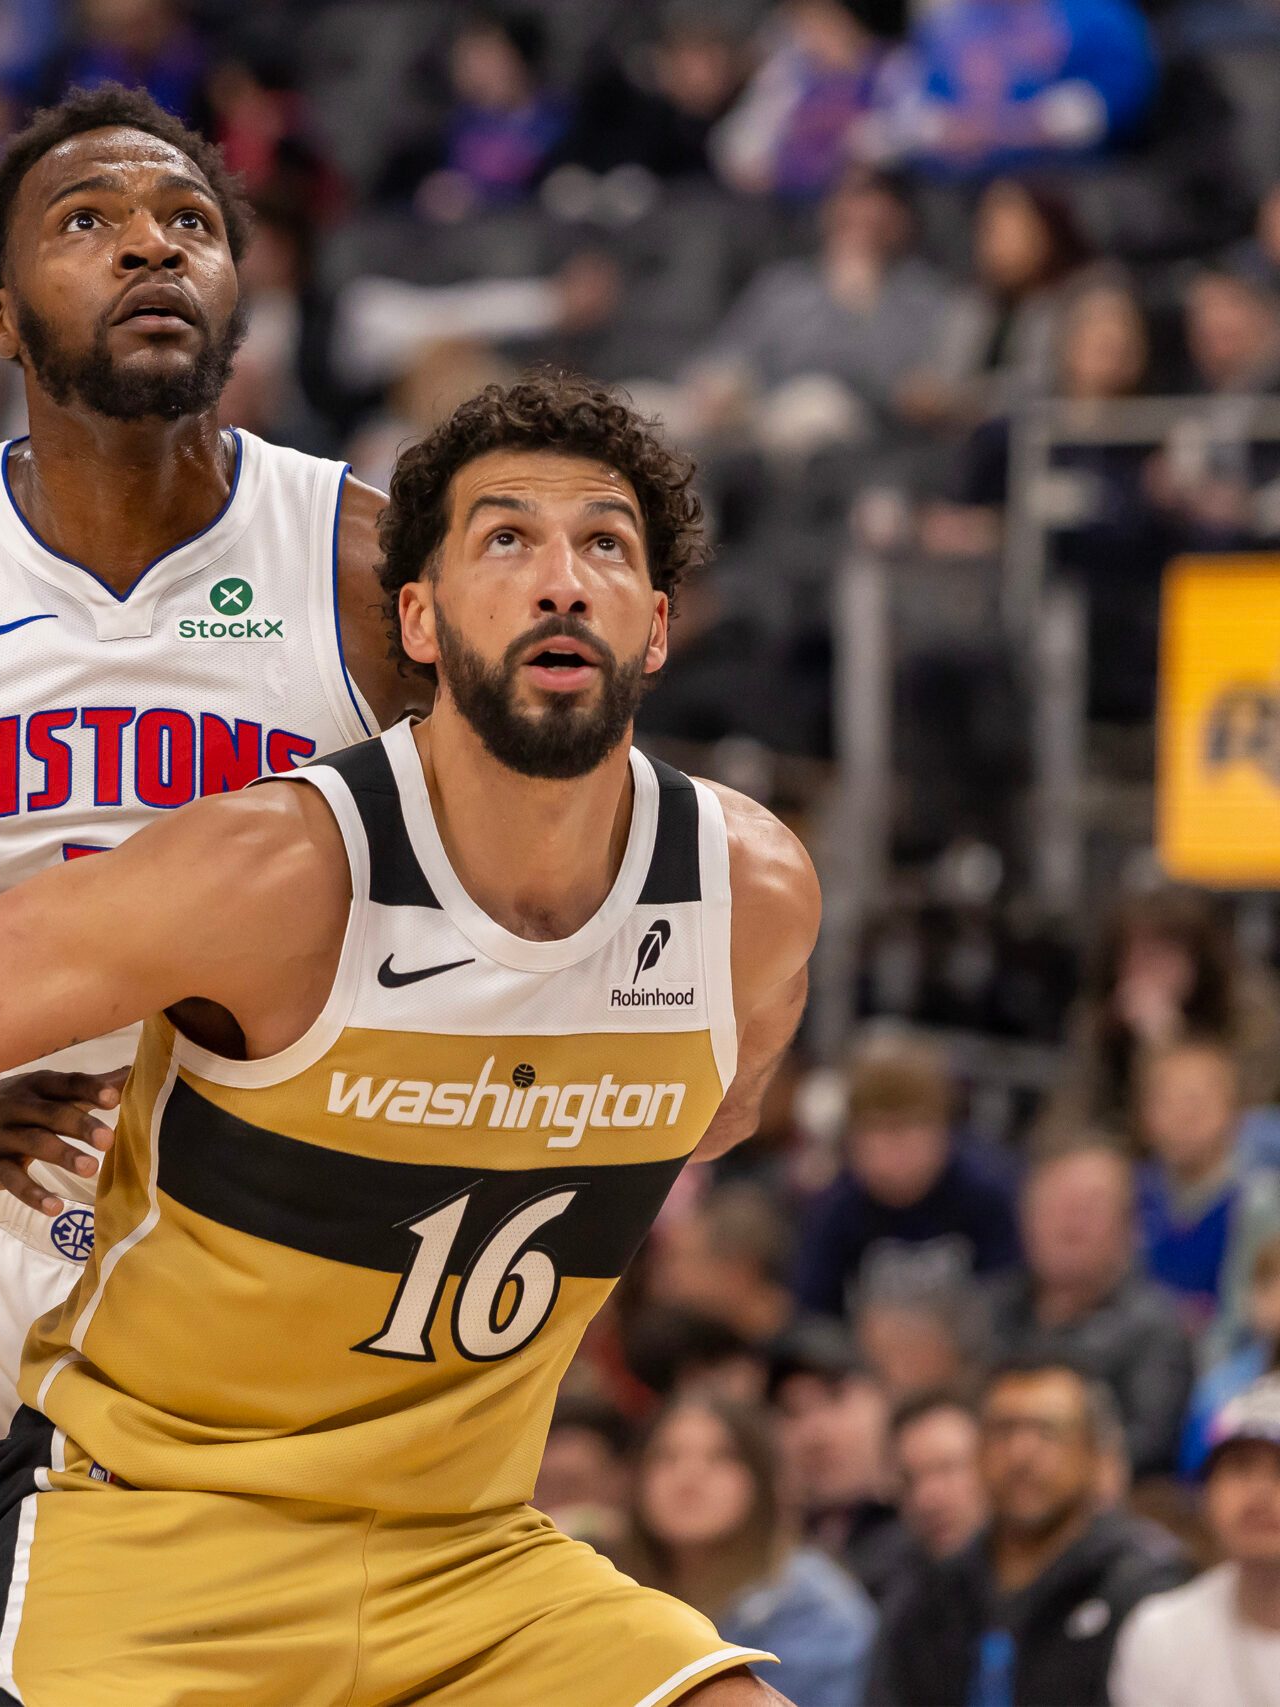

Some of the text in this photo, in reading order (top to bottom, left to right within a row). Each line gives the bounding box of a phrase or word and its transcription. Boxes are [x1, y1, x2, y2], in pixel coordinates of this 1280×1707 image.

[178, 618, 284, 639] StockX
[610, 987, 695, 1007] Robinhood
[323, 1055, 687, 1149] washington
[348, 1186, 582, 1364] 16
